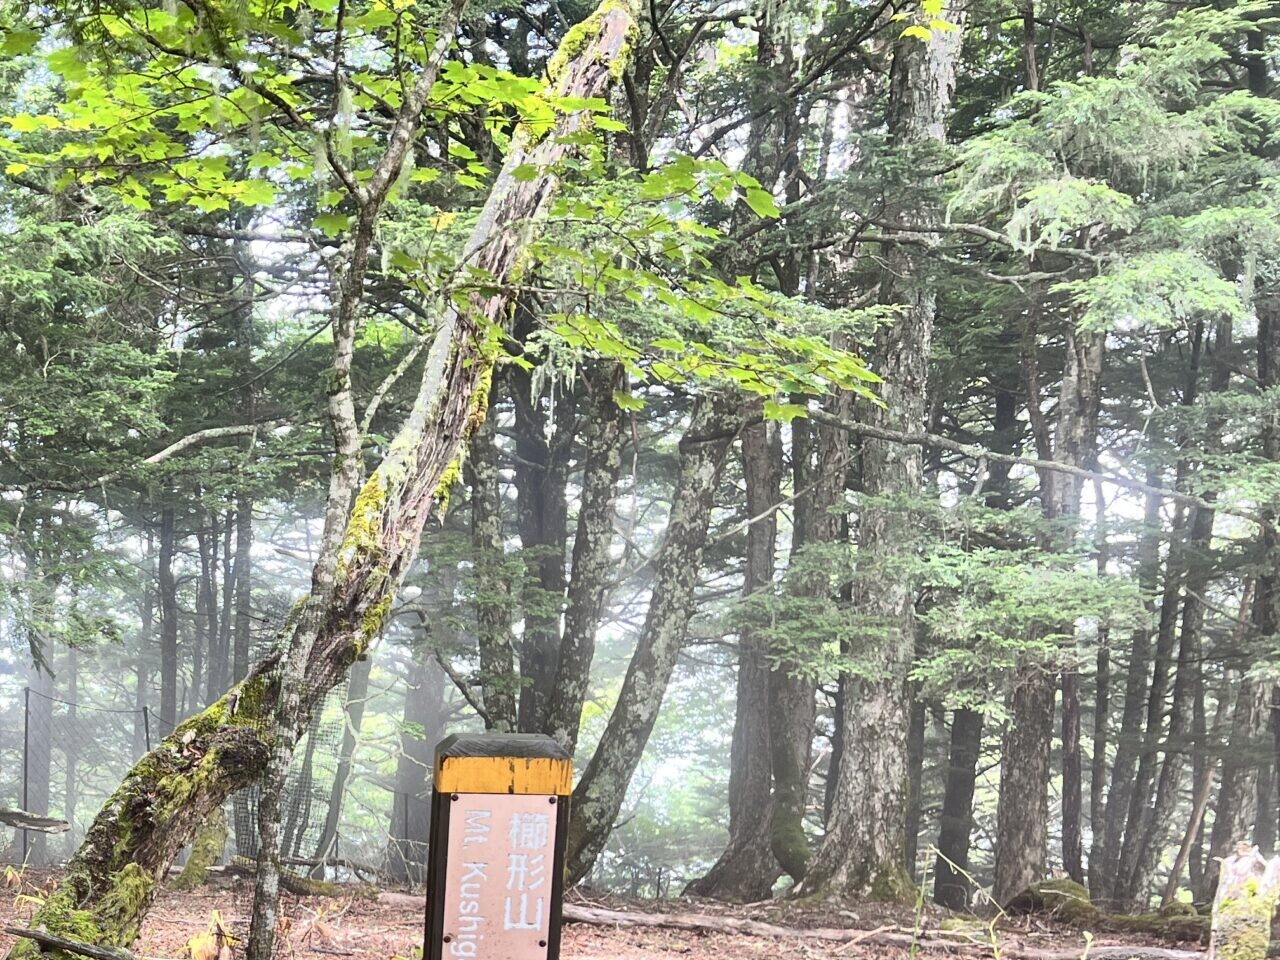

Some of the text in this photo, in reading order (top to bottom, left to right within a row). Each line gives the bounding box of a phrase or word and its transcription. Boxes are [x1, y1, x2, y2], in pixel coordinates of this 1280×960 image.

[463, 809, 492, 850] Mt.
[504, 812, 549, 931] 櫛形山
